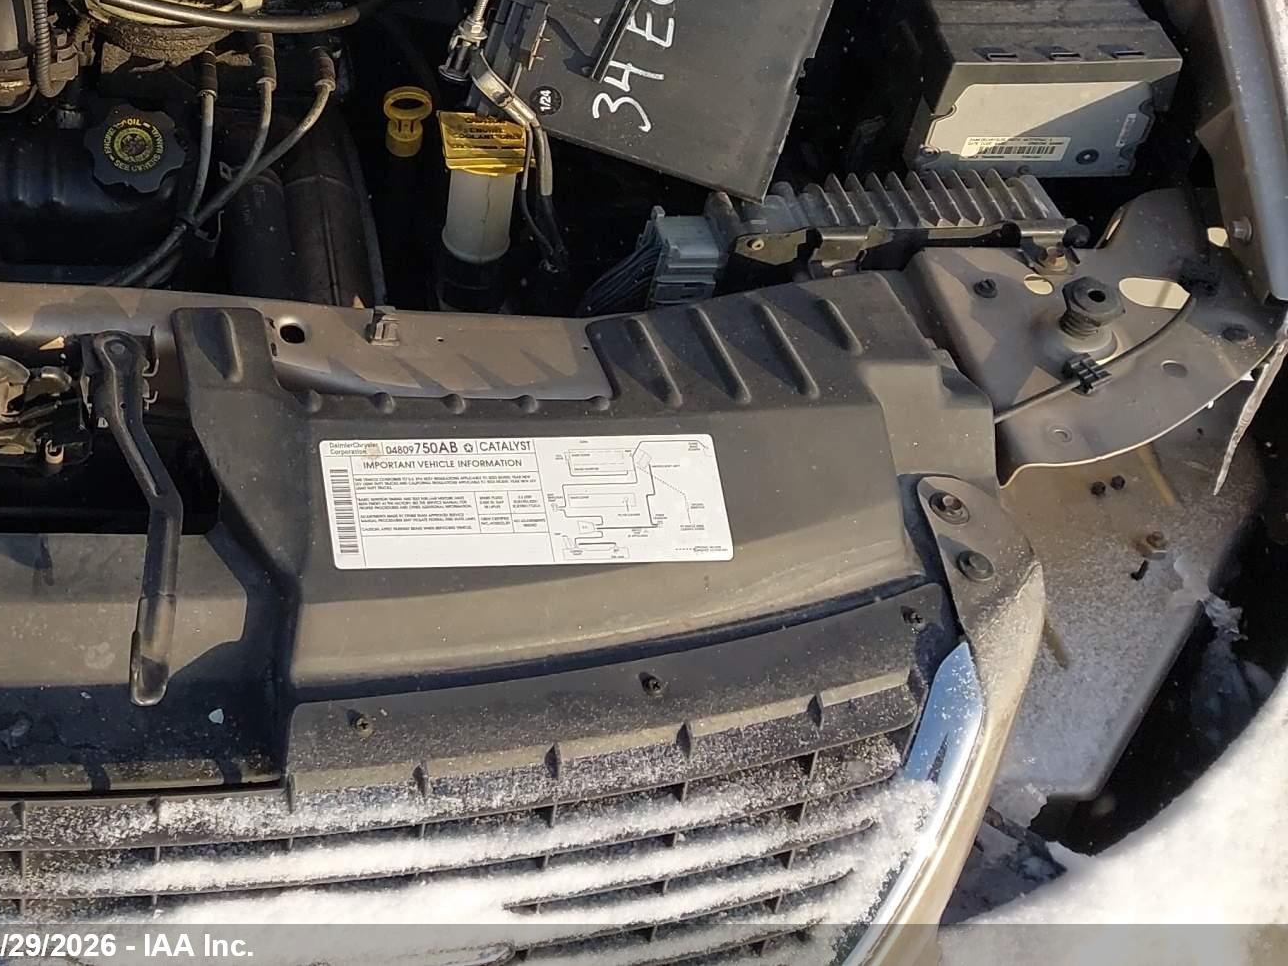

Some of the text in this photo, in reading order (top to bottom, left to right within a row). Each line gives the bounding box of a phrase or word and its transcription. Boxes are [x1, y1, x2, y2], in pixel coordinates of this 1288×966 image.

[540, 89, 552, 112] 1/24
[126, 118, 142, 127] OIL
[385, 441, 458, 455] 04809750AB
[478, 440, 531, 452] CATALYST
[362, 459, 523, 470] IMPORTANT VEHICLE INFORMATION
